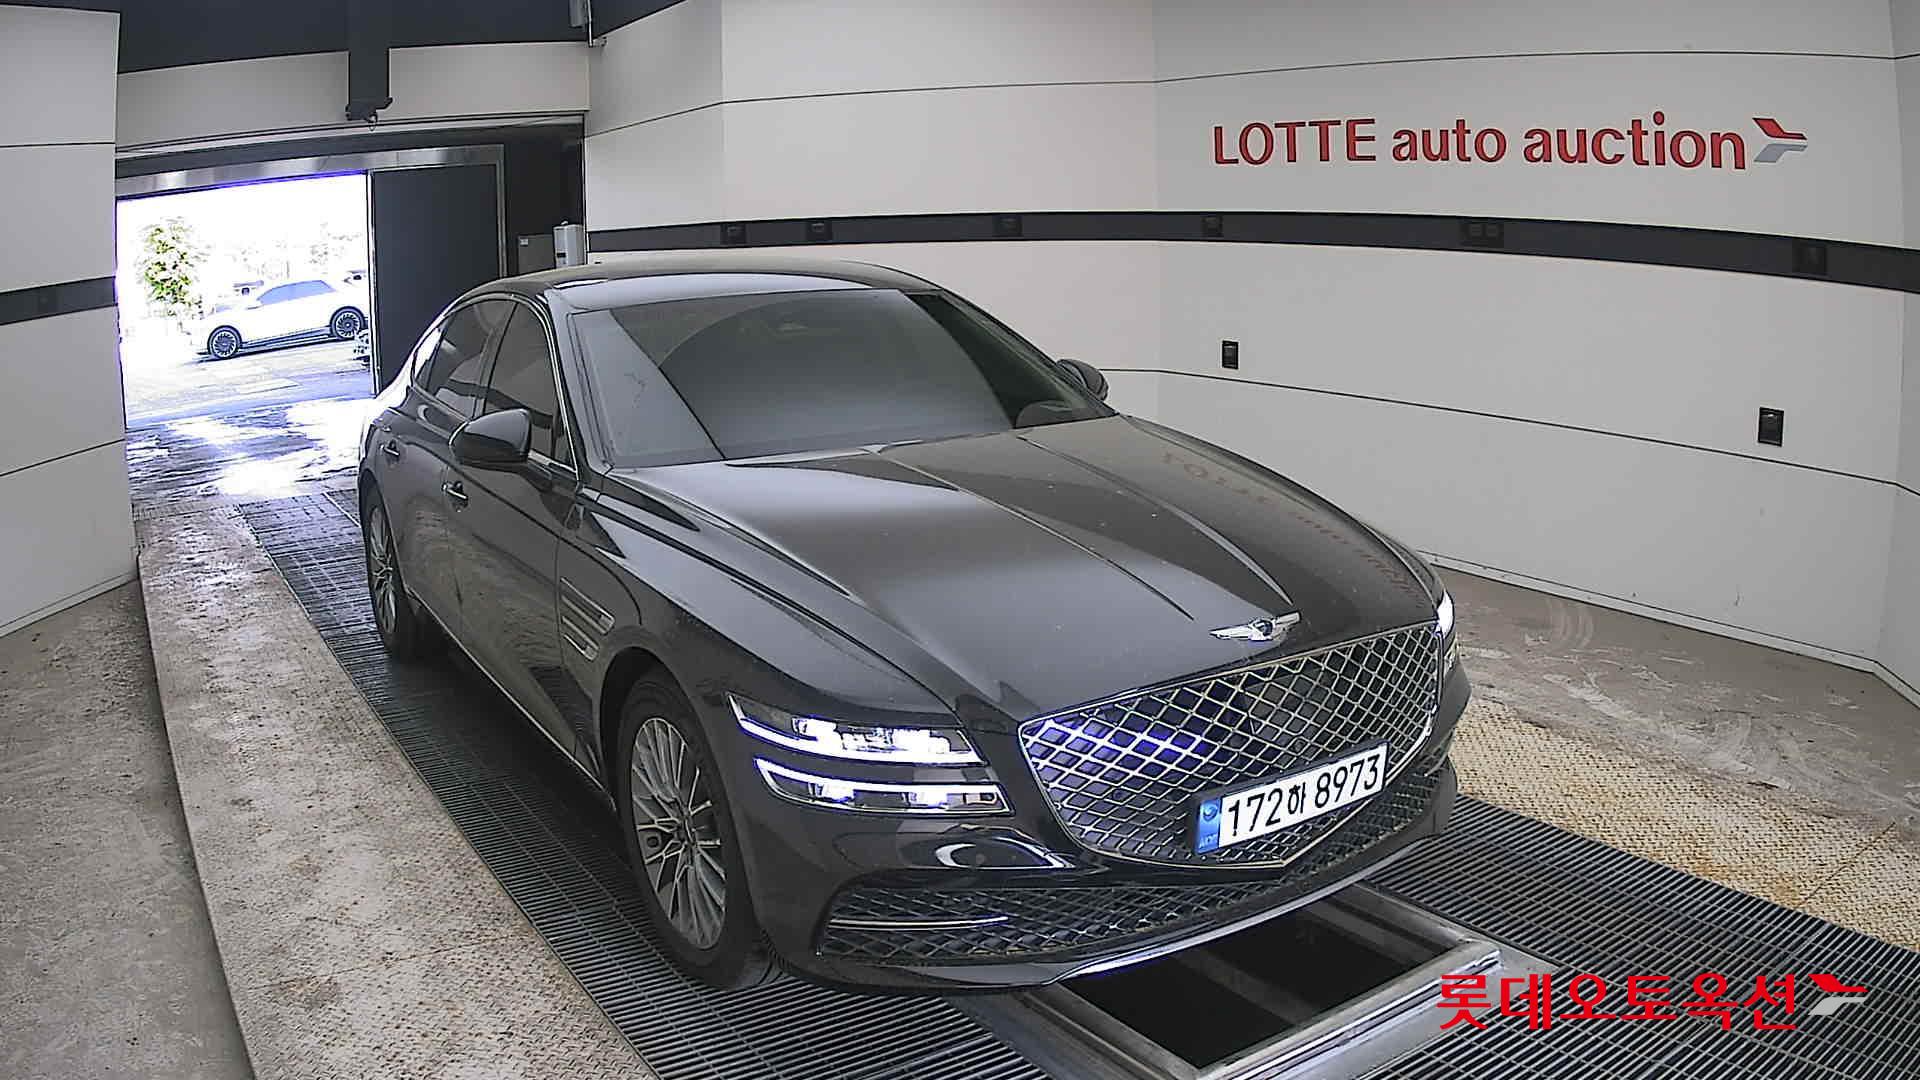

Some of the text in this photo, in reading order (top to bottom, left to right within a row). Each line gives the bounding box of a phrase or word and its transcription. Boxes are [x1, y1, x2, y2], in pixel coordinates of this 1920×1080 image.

[1213, 111, 1747, 170] LOTTE auto auction
[1228, 754, 1381, 837] 172하 8973
